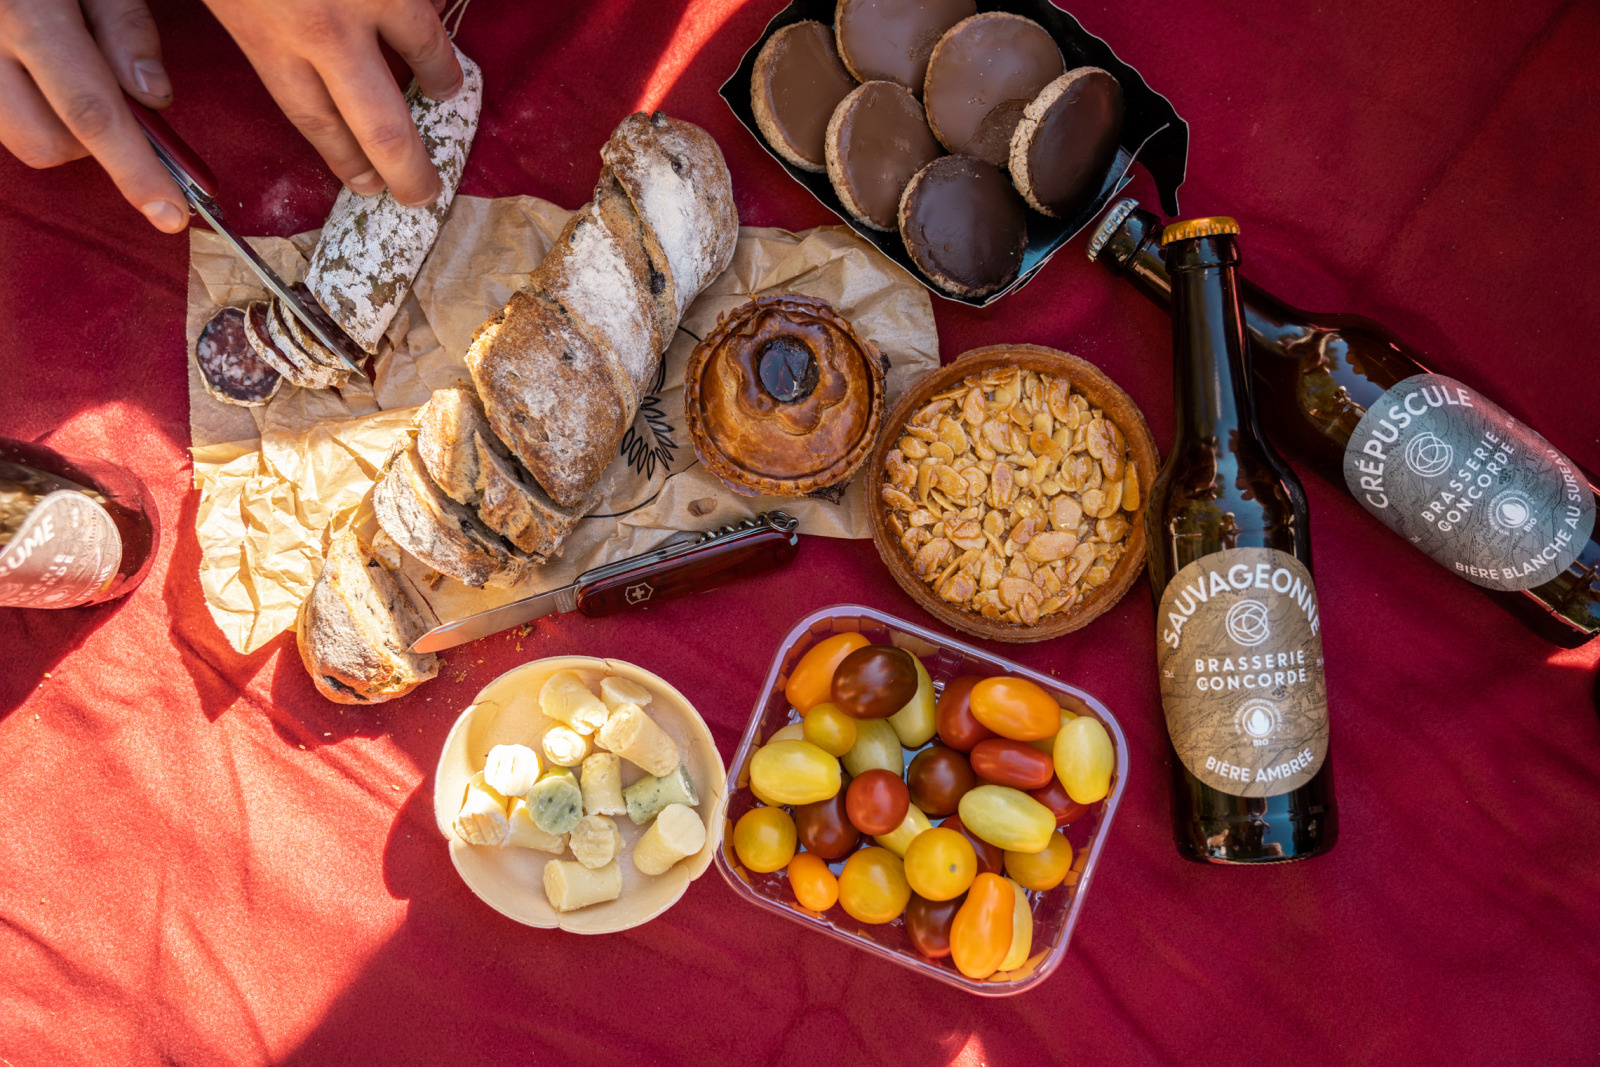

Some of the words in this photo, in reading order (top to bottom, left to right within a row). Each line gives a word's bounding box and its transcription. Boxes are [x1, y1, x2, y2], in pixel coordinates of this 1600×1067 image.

[1354, 385, 1474, 509] CRÉPUSCULE
[1421, 430, 1500, 523] BRASSERIE
[1437, 442, 1515, 532] CONCORDE
[1547, 449, 1582, 503] SUREAU
[1523, 518, 1537, 532] BIO
[1564, 506, 1582, 530] AU
[1455, 561, 1500, 580] BIÈRE
[1502, 528, 1573, 580] BLANCHE
[1163, 563, 1320, 649] SAUVAGEONNE
[1195, 650, 1305, 673] BRASSERIE
[1196, 668, 1307, 691] CONCORDE
[1253, 738, 1269, 747] BIO
[1205, 756, 1250, 782] BIÈRE
[1255, 747, 1314, 783] AMBRÉE
